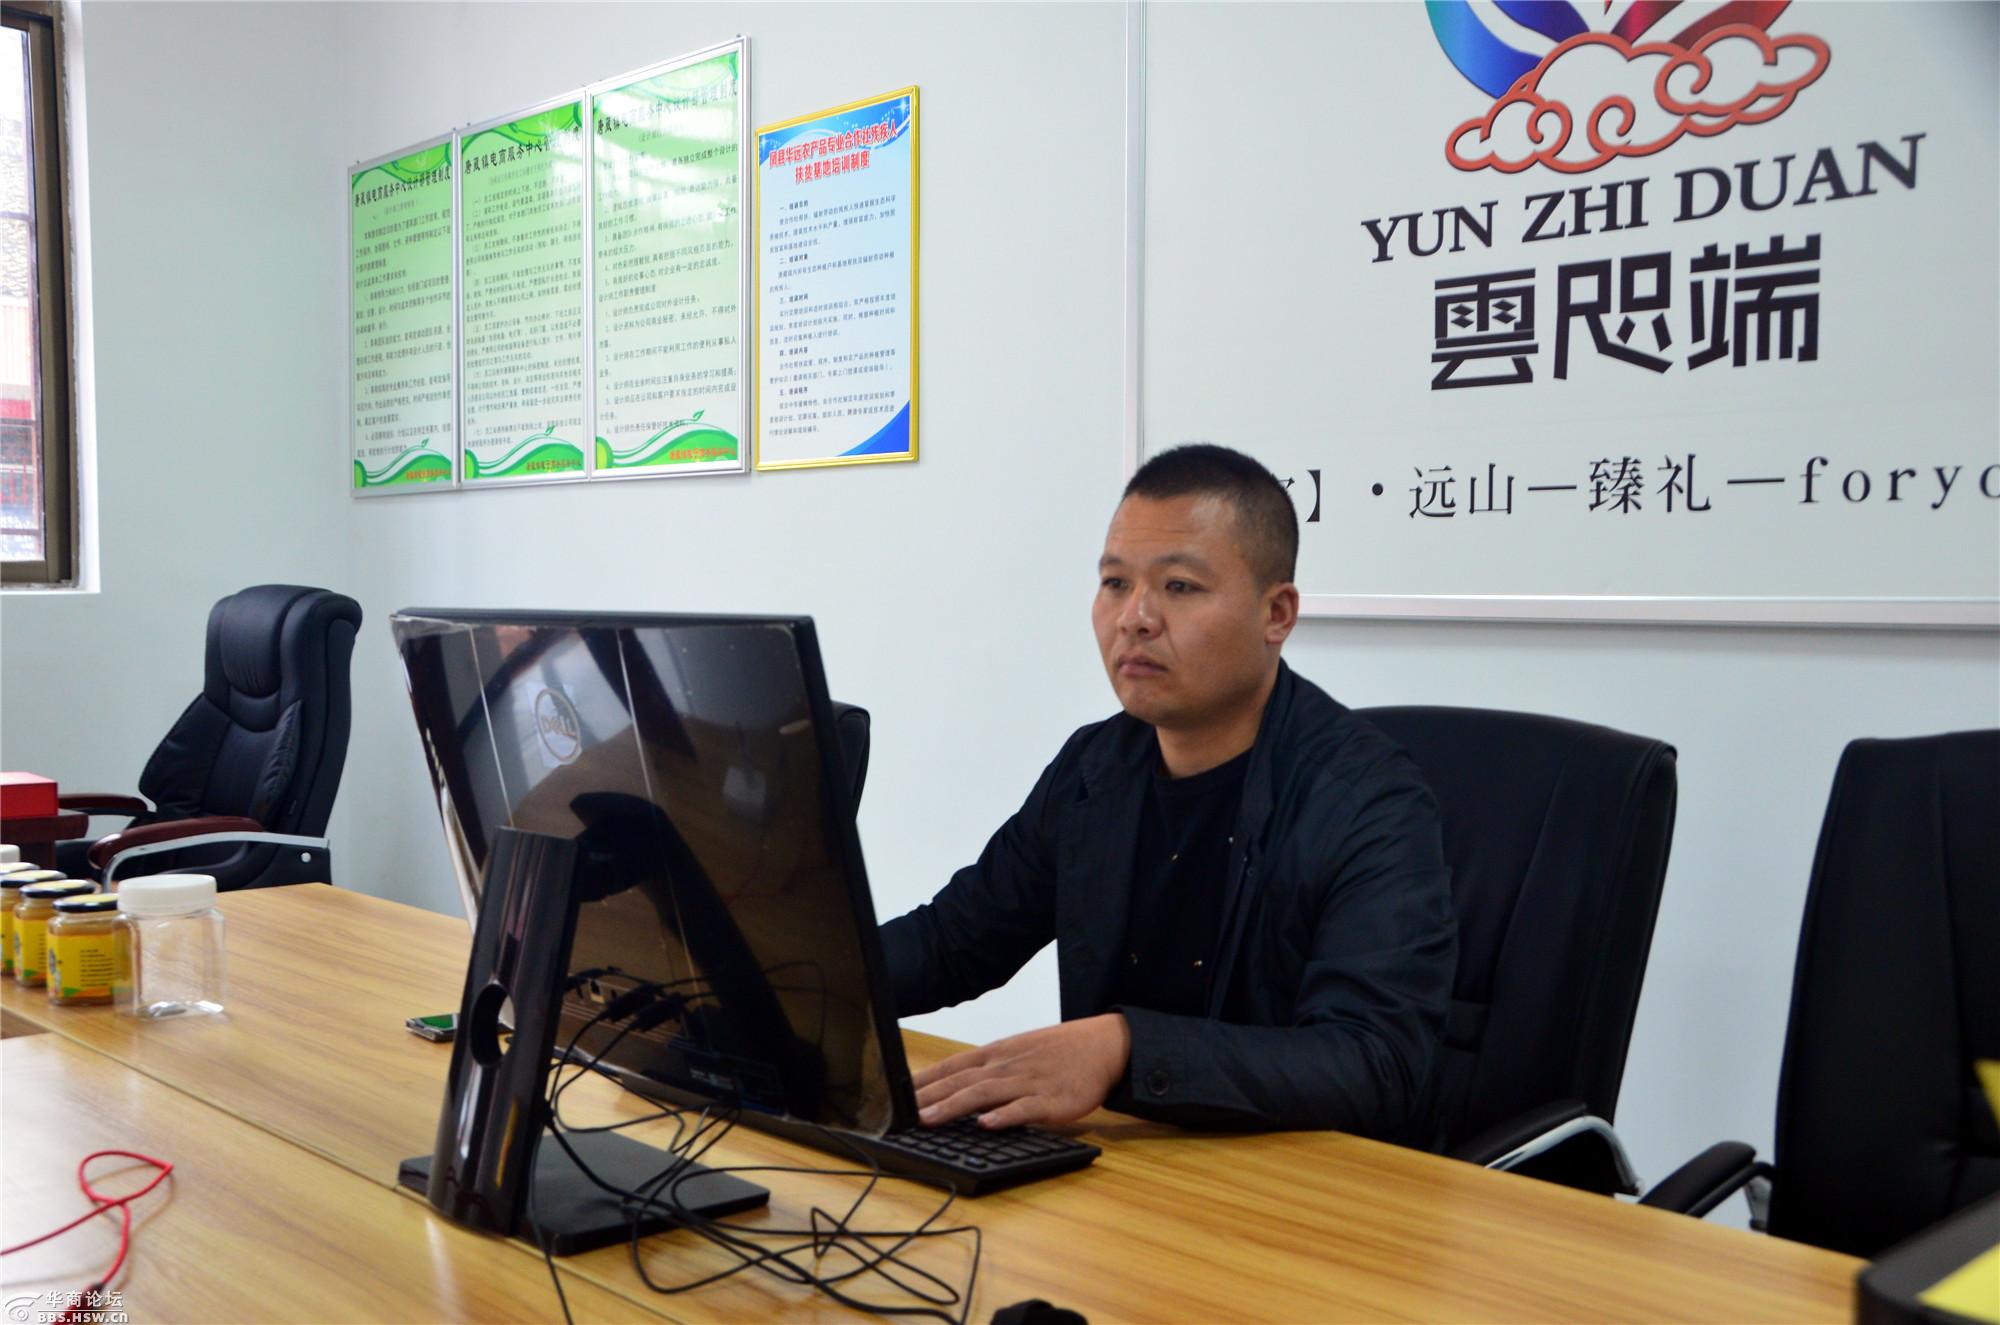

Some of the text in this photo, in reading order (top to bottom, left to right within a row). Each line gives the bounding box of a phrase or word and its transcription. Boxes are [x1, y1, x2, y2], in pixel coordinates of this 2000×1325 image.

[1361, 133, 1927, 264] YUN ZHI DUAN
